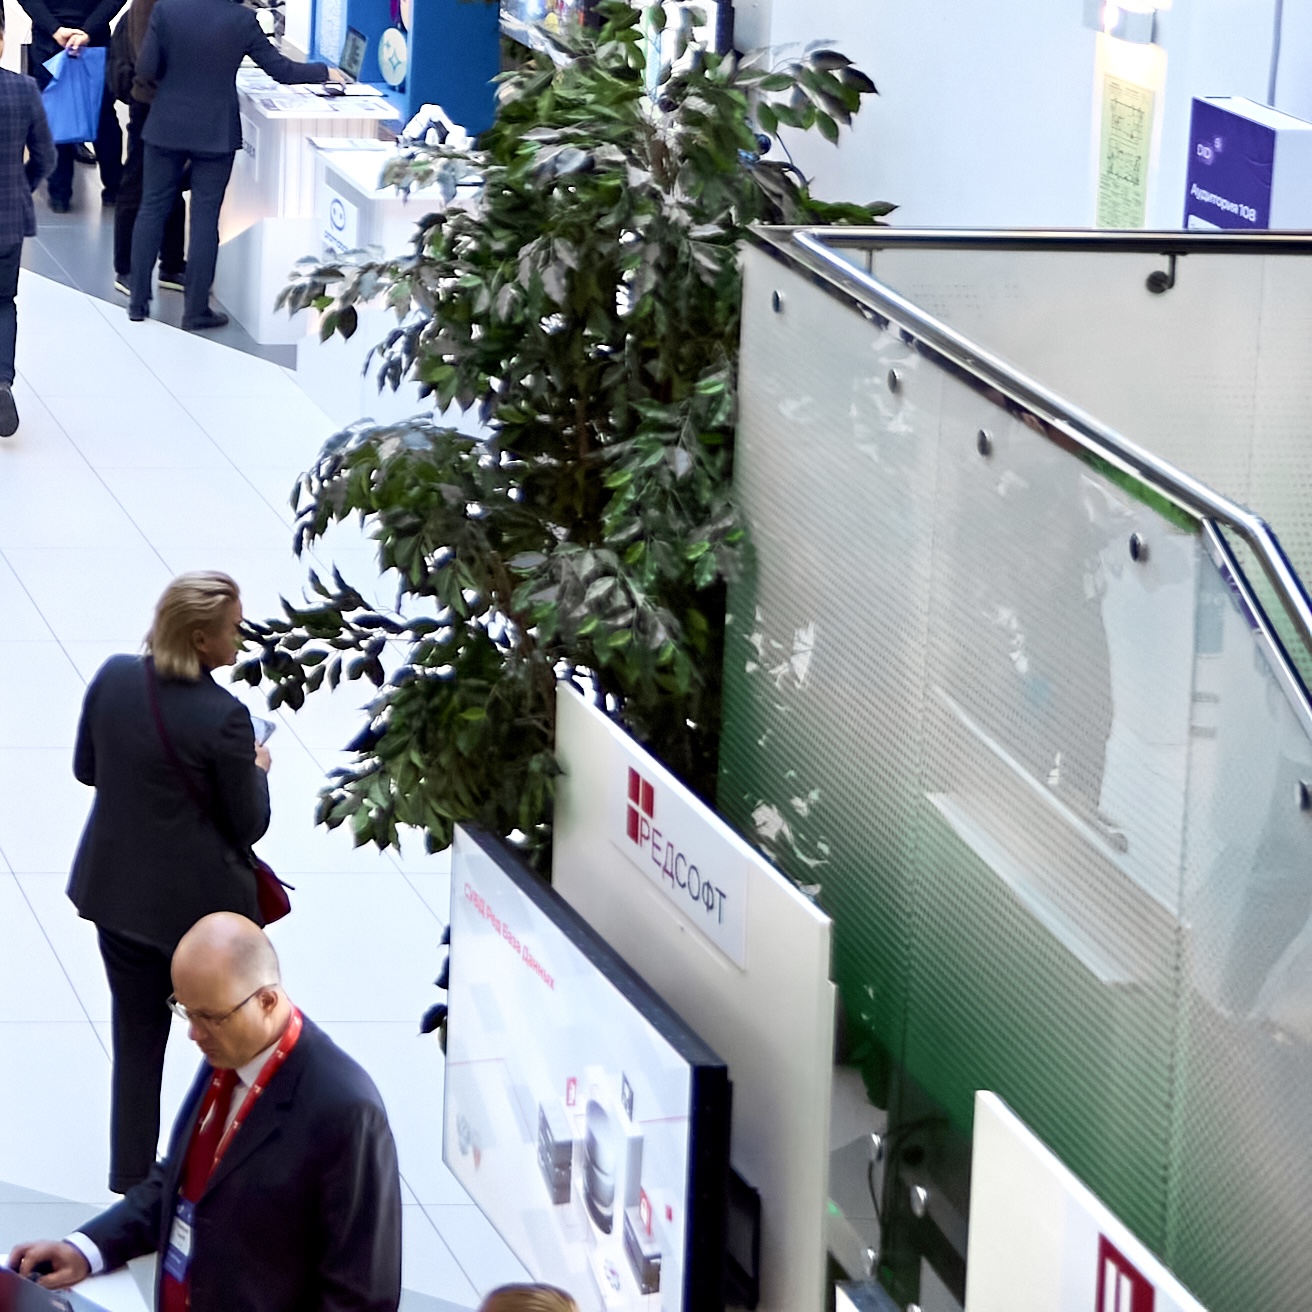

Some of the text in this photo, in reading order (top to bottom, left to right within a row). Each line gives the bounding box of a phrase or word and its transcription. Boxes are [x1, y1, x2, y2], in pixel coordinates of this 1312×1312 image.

[1190, 183, 1257, 223] Аудитория 108
[638, 817, 727, 925] РЕДСОФТ
